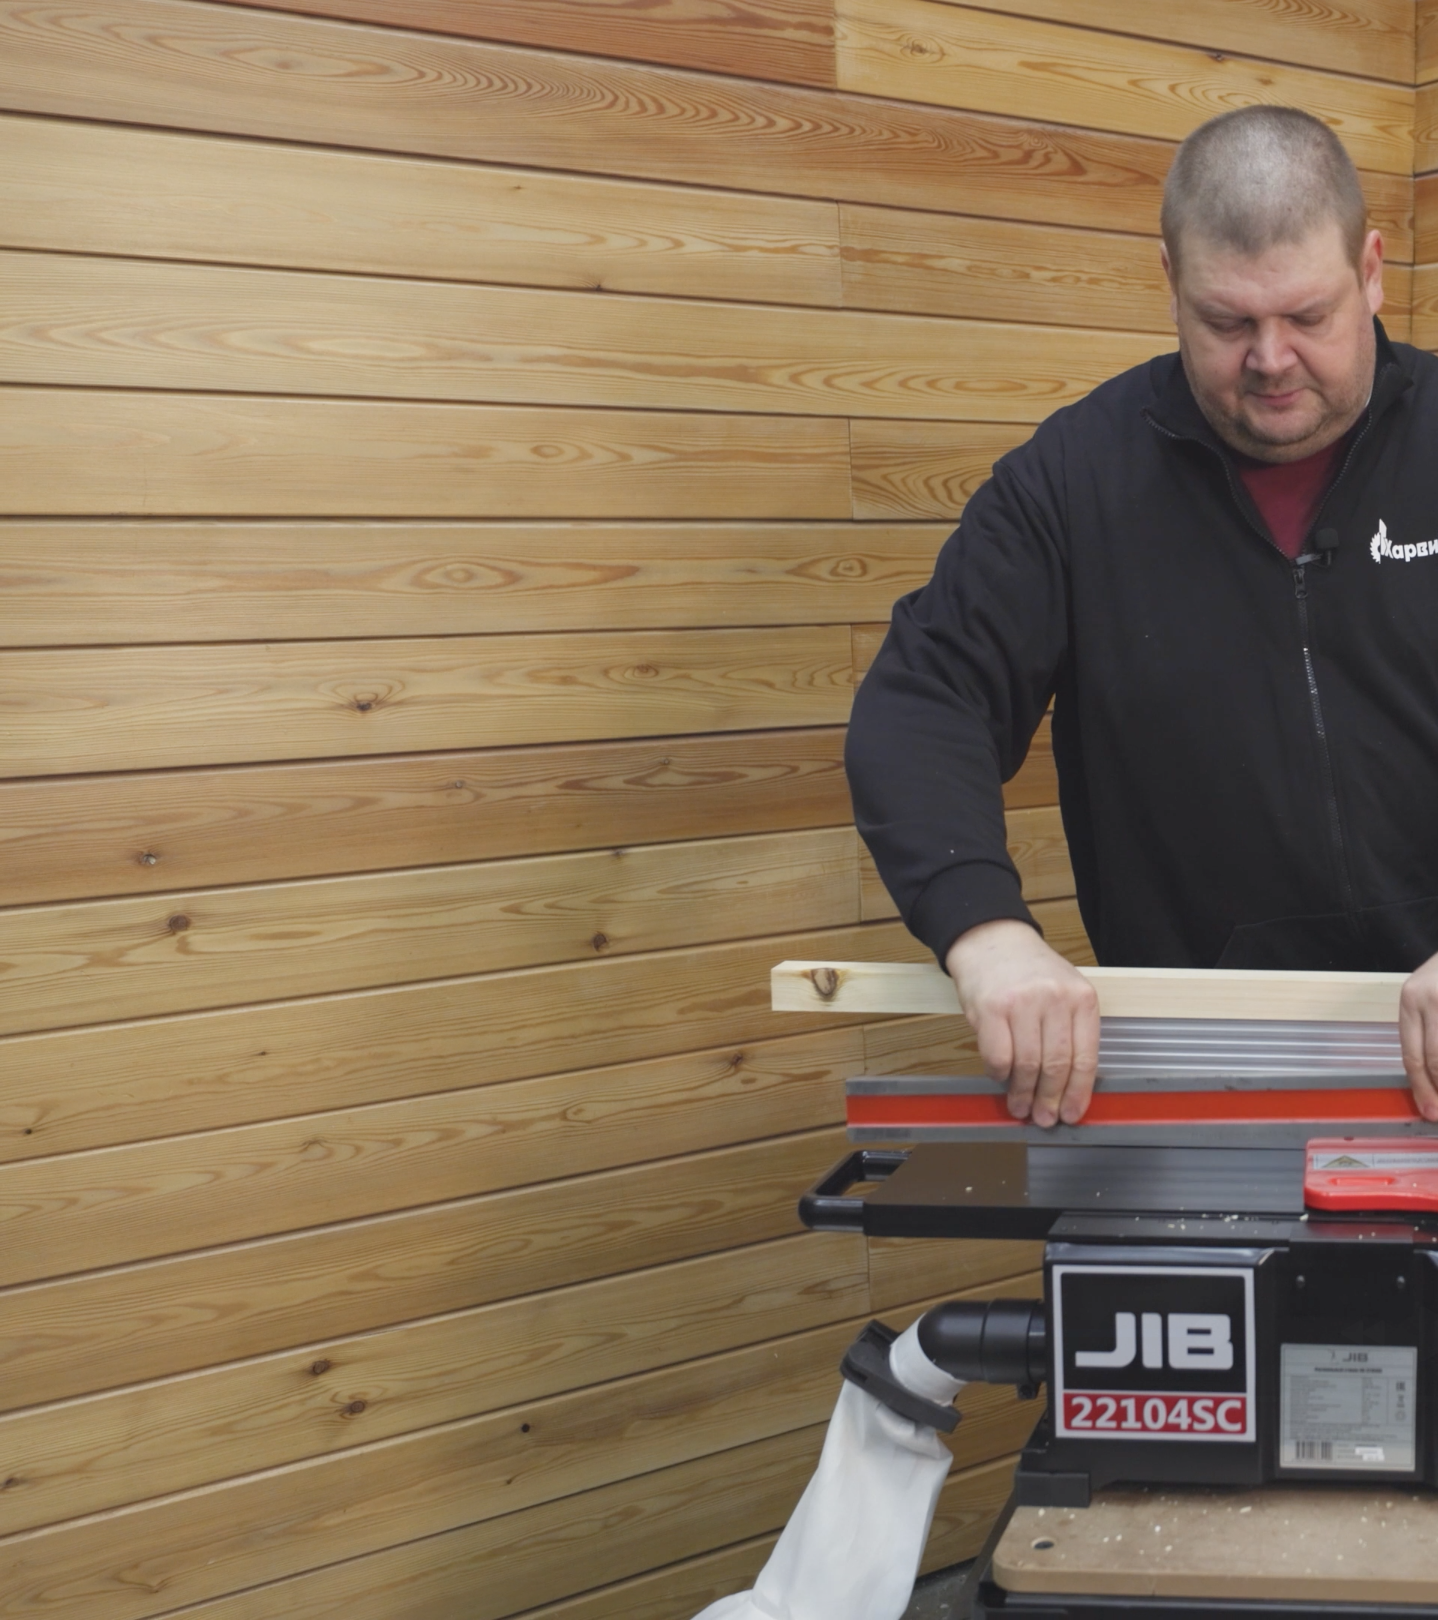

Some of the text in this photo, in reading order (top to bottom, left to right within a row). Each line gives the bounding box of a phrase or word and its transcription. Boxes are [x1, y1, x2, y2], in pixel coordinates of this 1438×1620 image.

[1075, 1312, 1234, 1370] JIB
[1342, 1352, 1369, 1363] JIB
[1070, 1396, 1242, 1432] 22104SC
